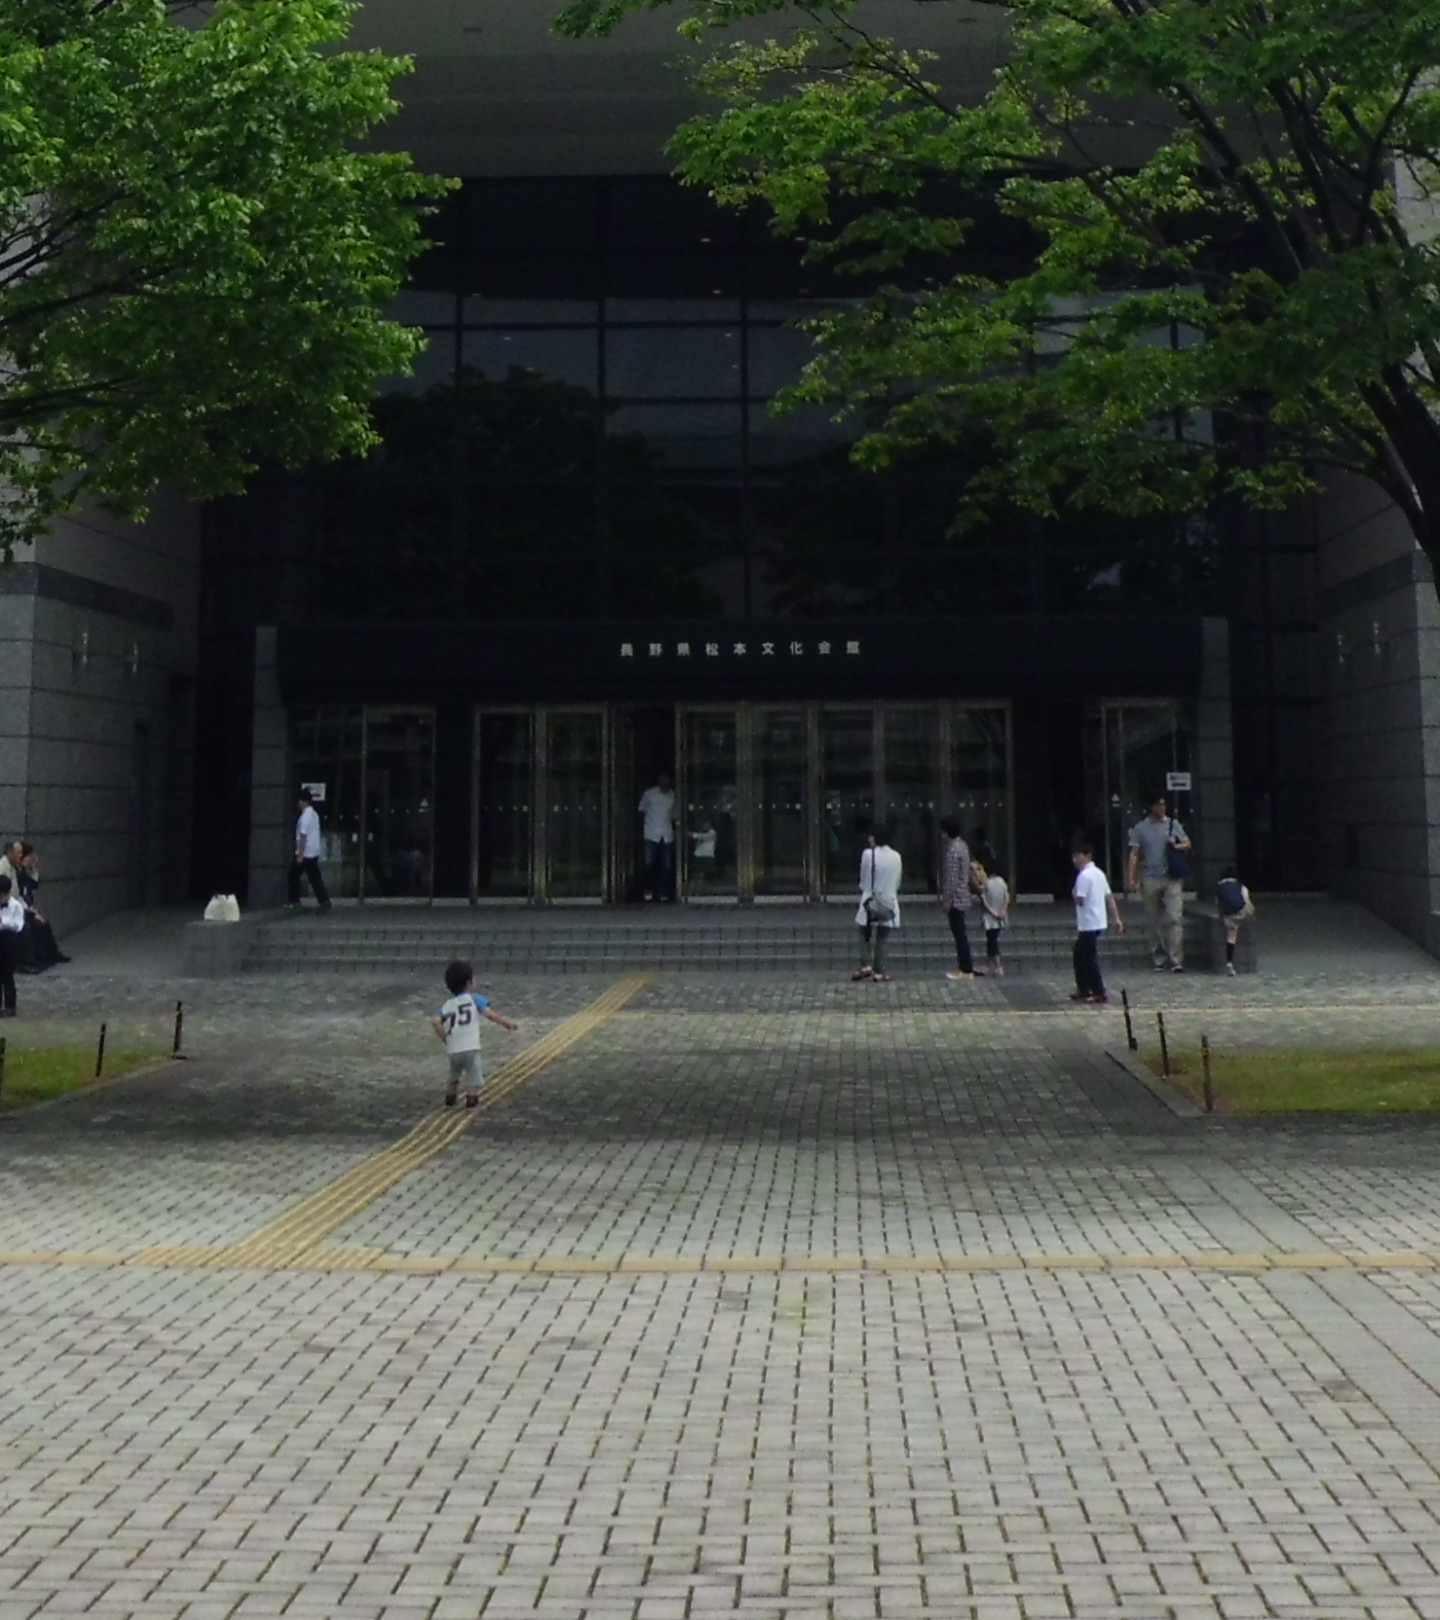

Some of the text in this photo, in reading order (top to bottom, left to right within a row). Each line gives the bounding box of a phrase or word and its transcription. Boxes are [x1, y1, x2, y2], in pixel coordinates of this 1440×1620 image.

[620, 641, 860, 657] 長野県松本文化会館
[441, 1002, 472, 1035] 75
